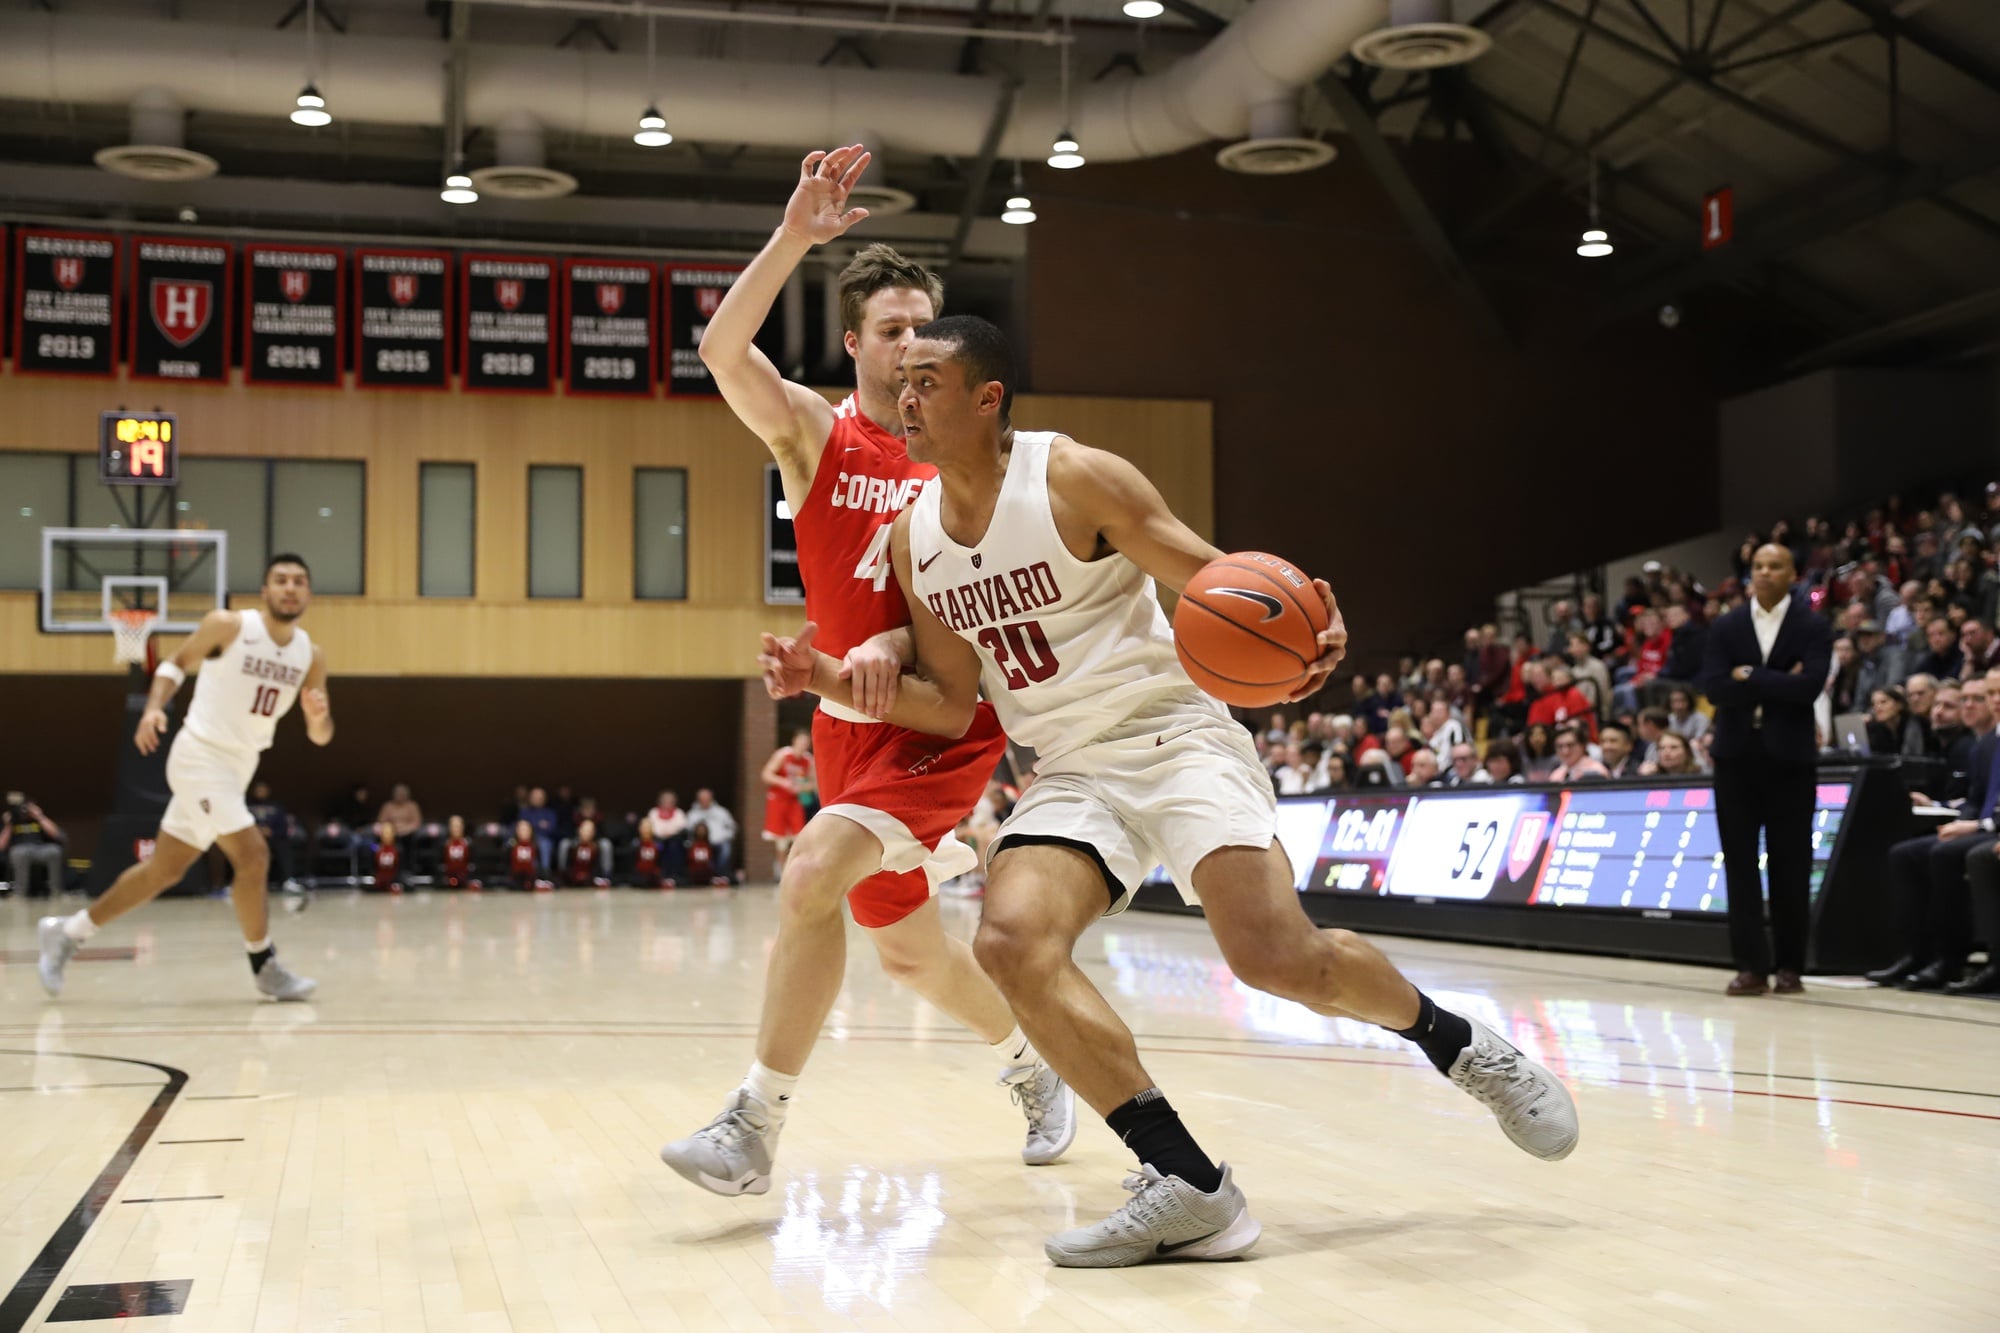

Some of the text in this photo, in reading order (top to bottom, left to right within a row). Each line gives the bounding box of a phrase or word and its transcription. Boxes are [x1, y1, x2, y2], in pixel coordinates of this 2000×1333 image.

[165, 286, 197, 328] H
[38, 334, 95, 359] 2013
[267, 345, 321, 370] 2014
[377, 349, 430, 373] 2015
[832, 471, 928, 514] CORNE
[853, 522, 893, 592] 4
[928, 561, 1062, 632] HARVARD
[978, 620, 1060, 690] 20
[250, 685, 280, 717] 10
[1331, 808, 1399, 852] 12:41
[1451, 820, 1498, 880] 52
